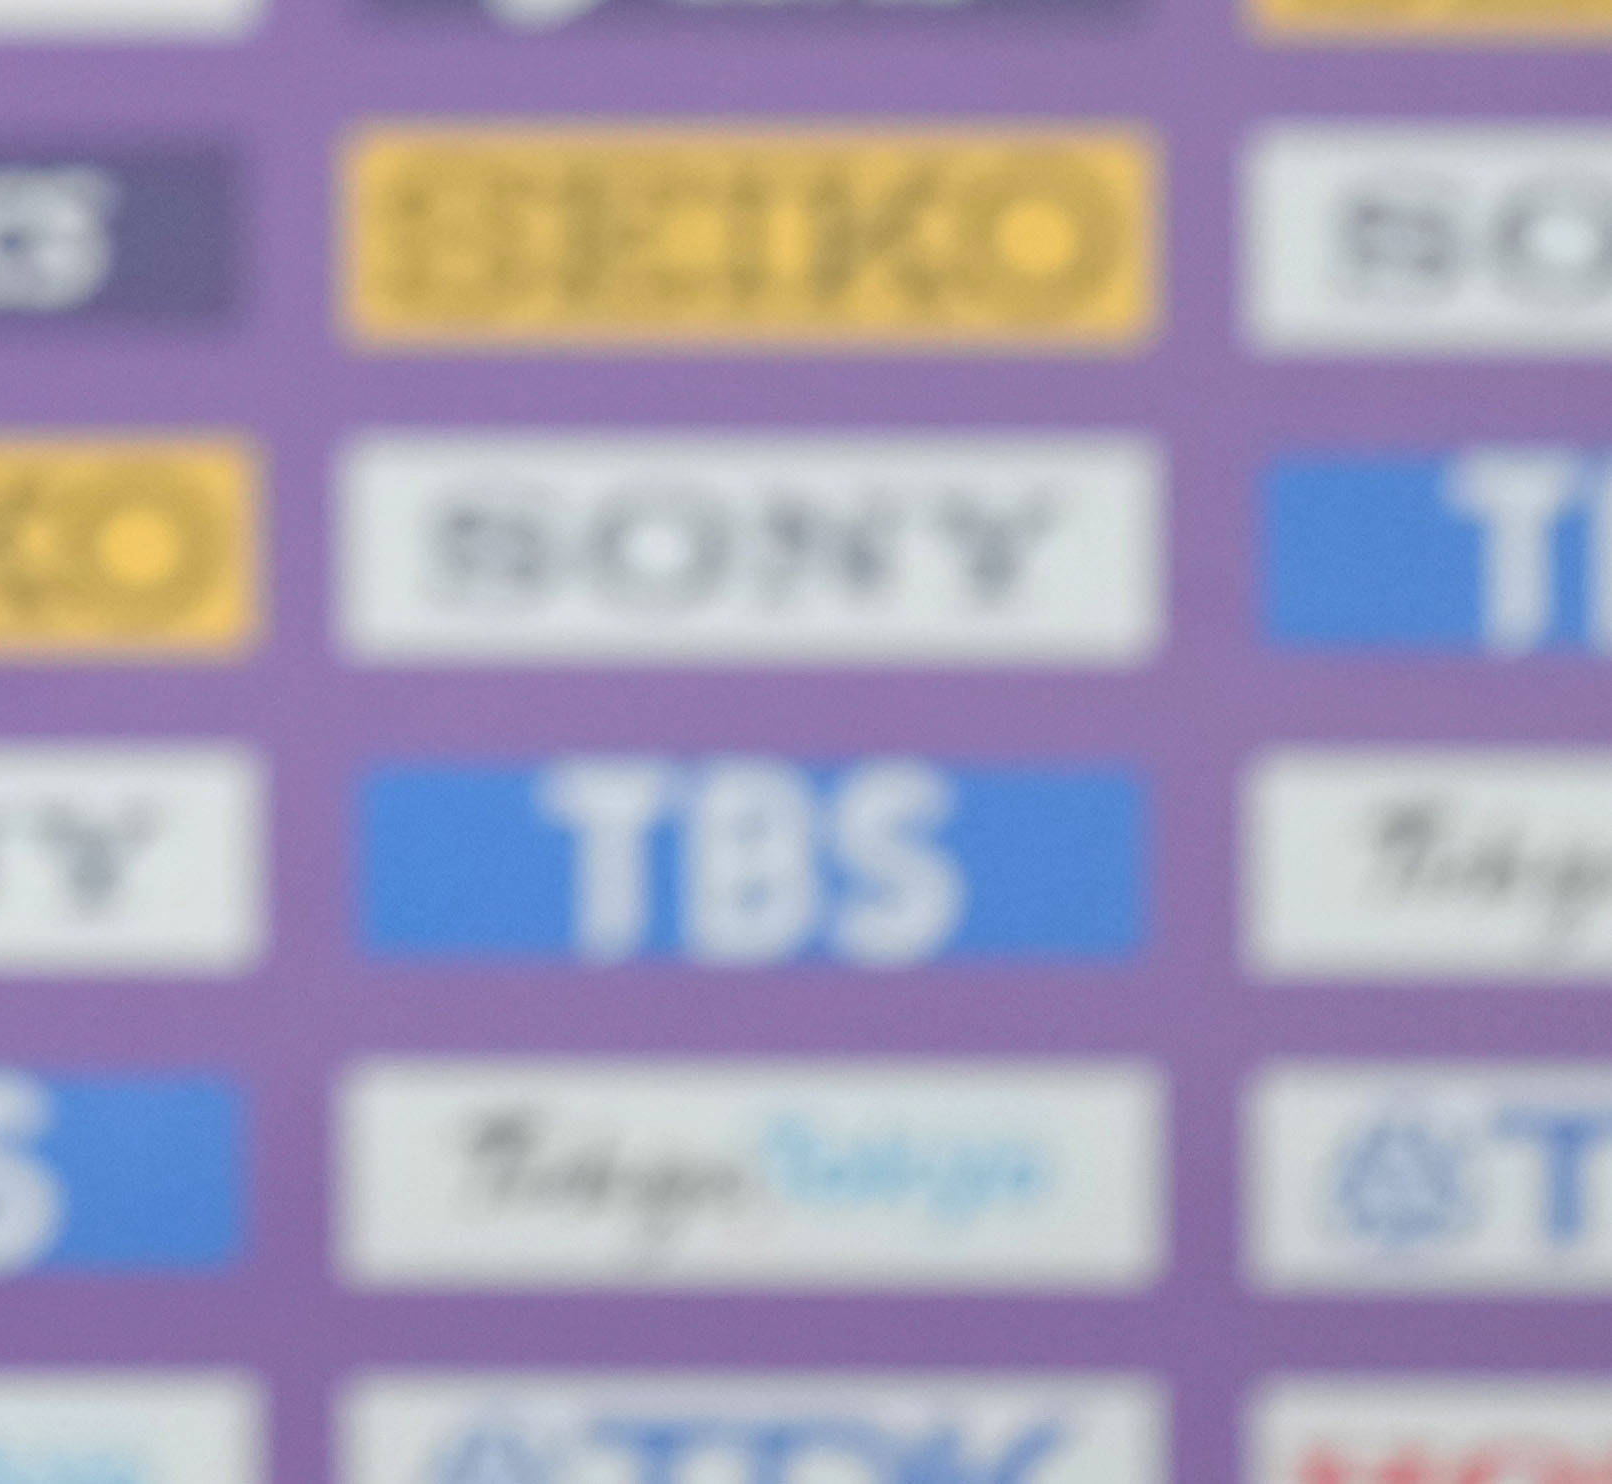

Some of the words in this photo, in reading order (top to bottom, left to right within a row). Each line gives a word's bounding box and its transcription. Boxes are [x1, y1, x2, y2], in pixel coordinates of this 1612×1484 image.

[385, 155, 1146, 317] SEIKO
[433, 492, 1068, 611] SONY
[539, 760, 967, 967] TBS
